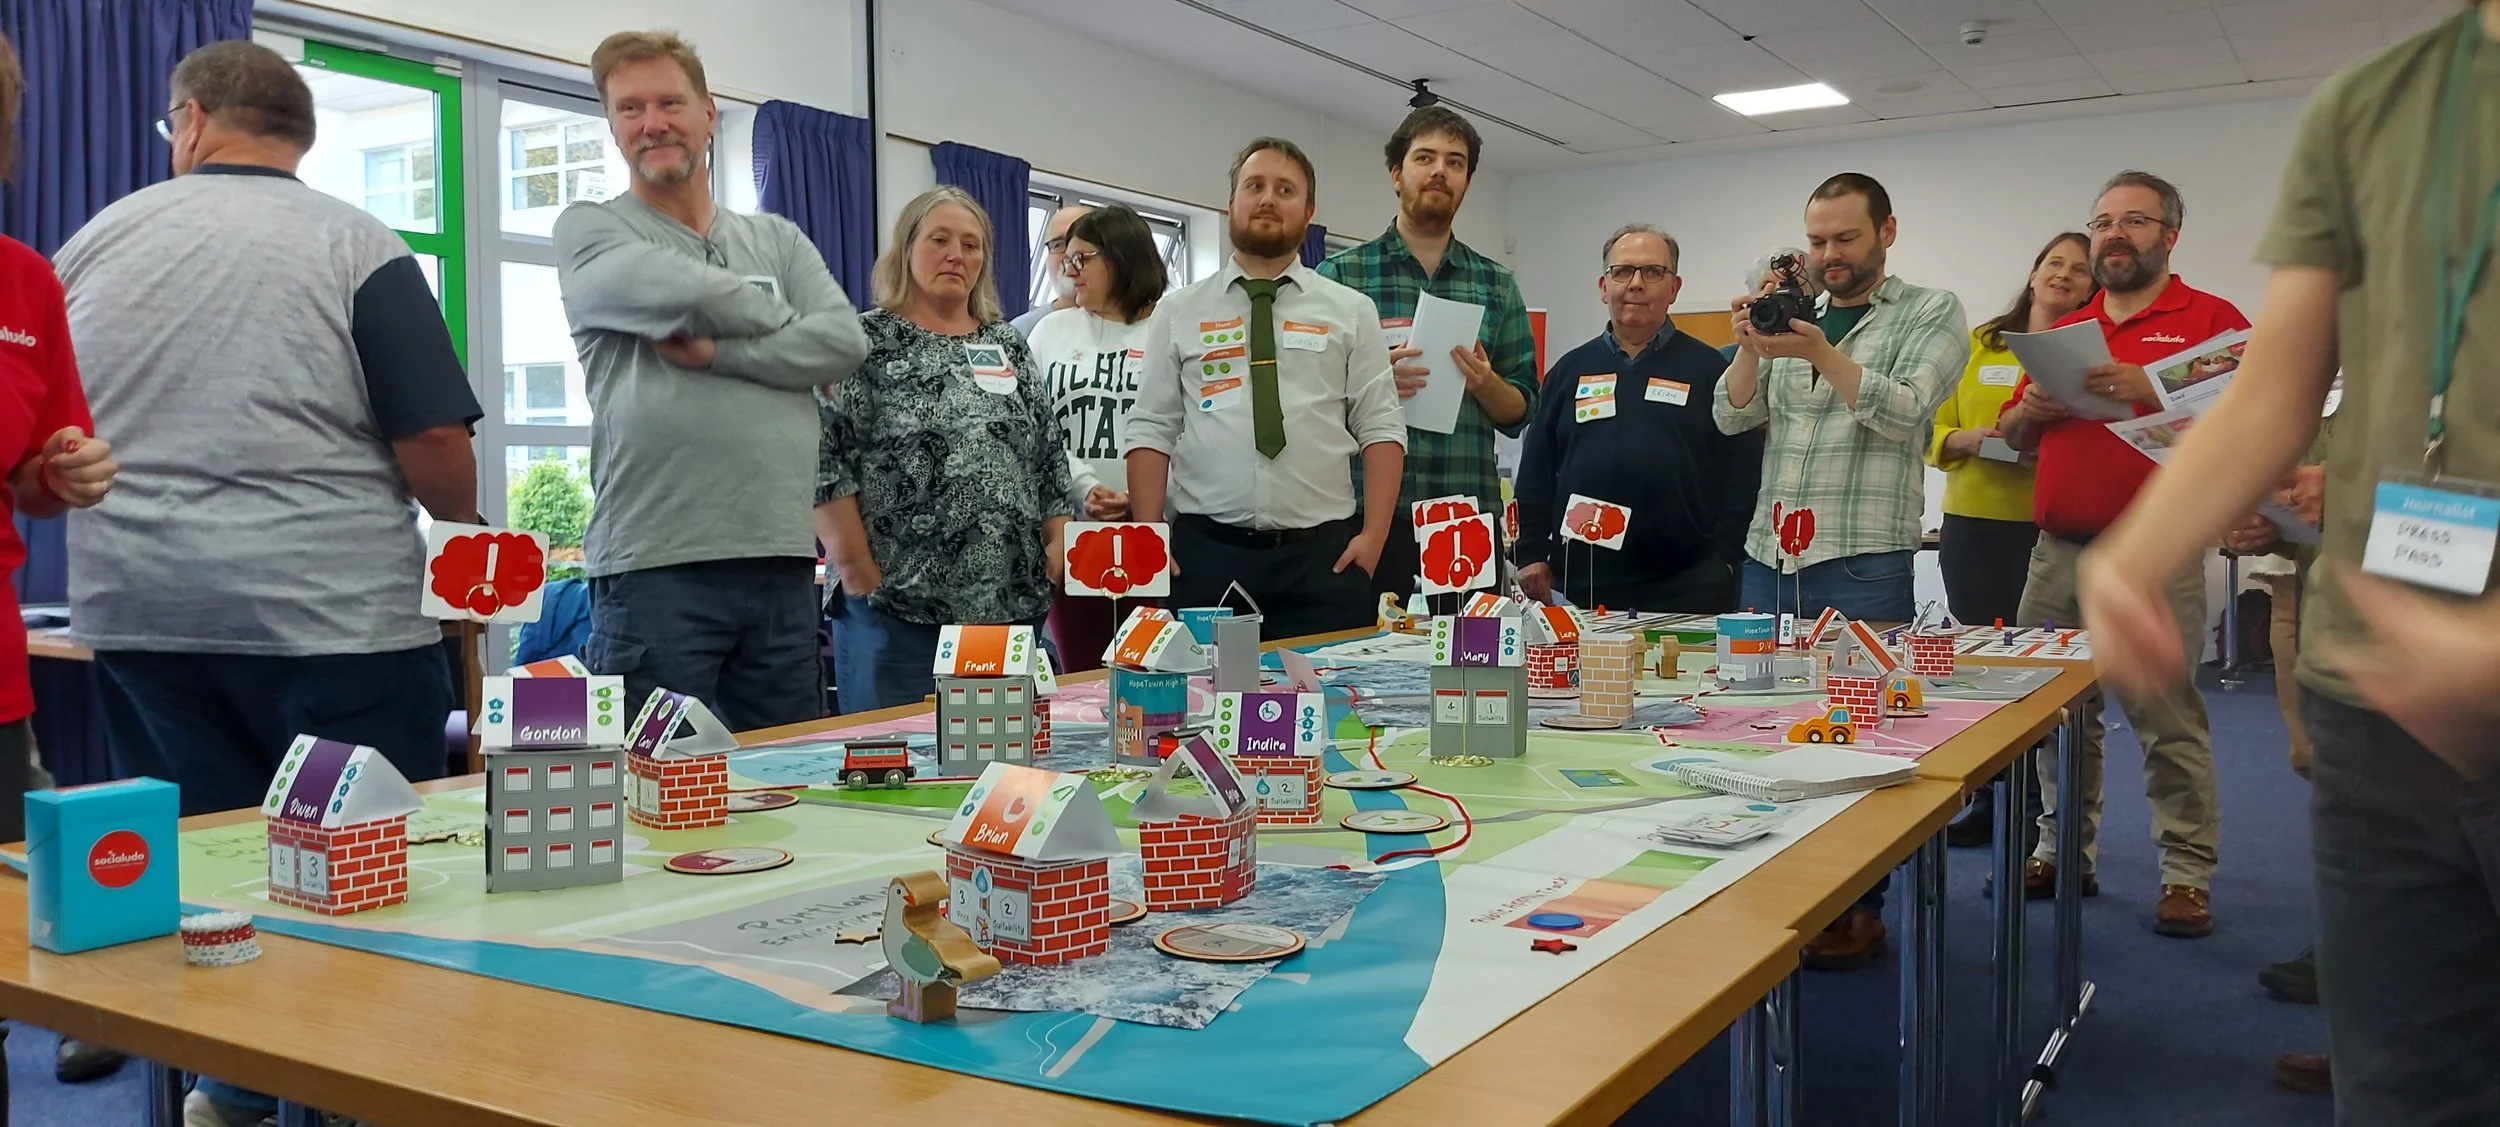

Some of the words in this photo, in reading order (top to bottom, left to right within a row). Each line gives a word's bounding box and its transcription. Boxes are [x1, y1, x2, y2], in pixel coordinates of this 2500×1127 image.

[2141, 332, 2185, 343] socialudo
[2394, 544, 2442, 568] PASS
[1460, 651, 1489, 664] Mary
[964, 660, 997, 672] Frank
[1448, 701, 1455, 710] 4
[520, 725, 581, 742] Gordon
[1247, 737, 1286, 751] Indira
[1281, 783, 1290, 793] 2
[289, 798, 319, 820] Owen
[973, 823, 1009, 845] Brian
[94, 850, 144, 867] socialudo
[279, 848, 286, 866] 6
[308, 856, 318, 878] 3
[959, 889, 966, 905] 3
[1004, 902, 1012, 915] 2
[993, 919, 1025, 936] Suitability
